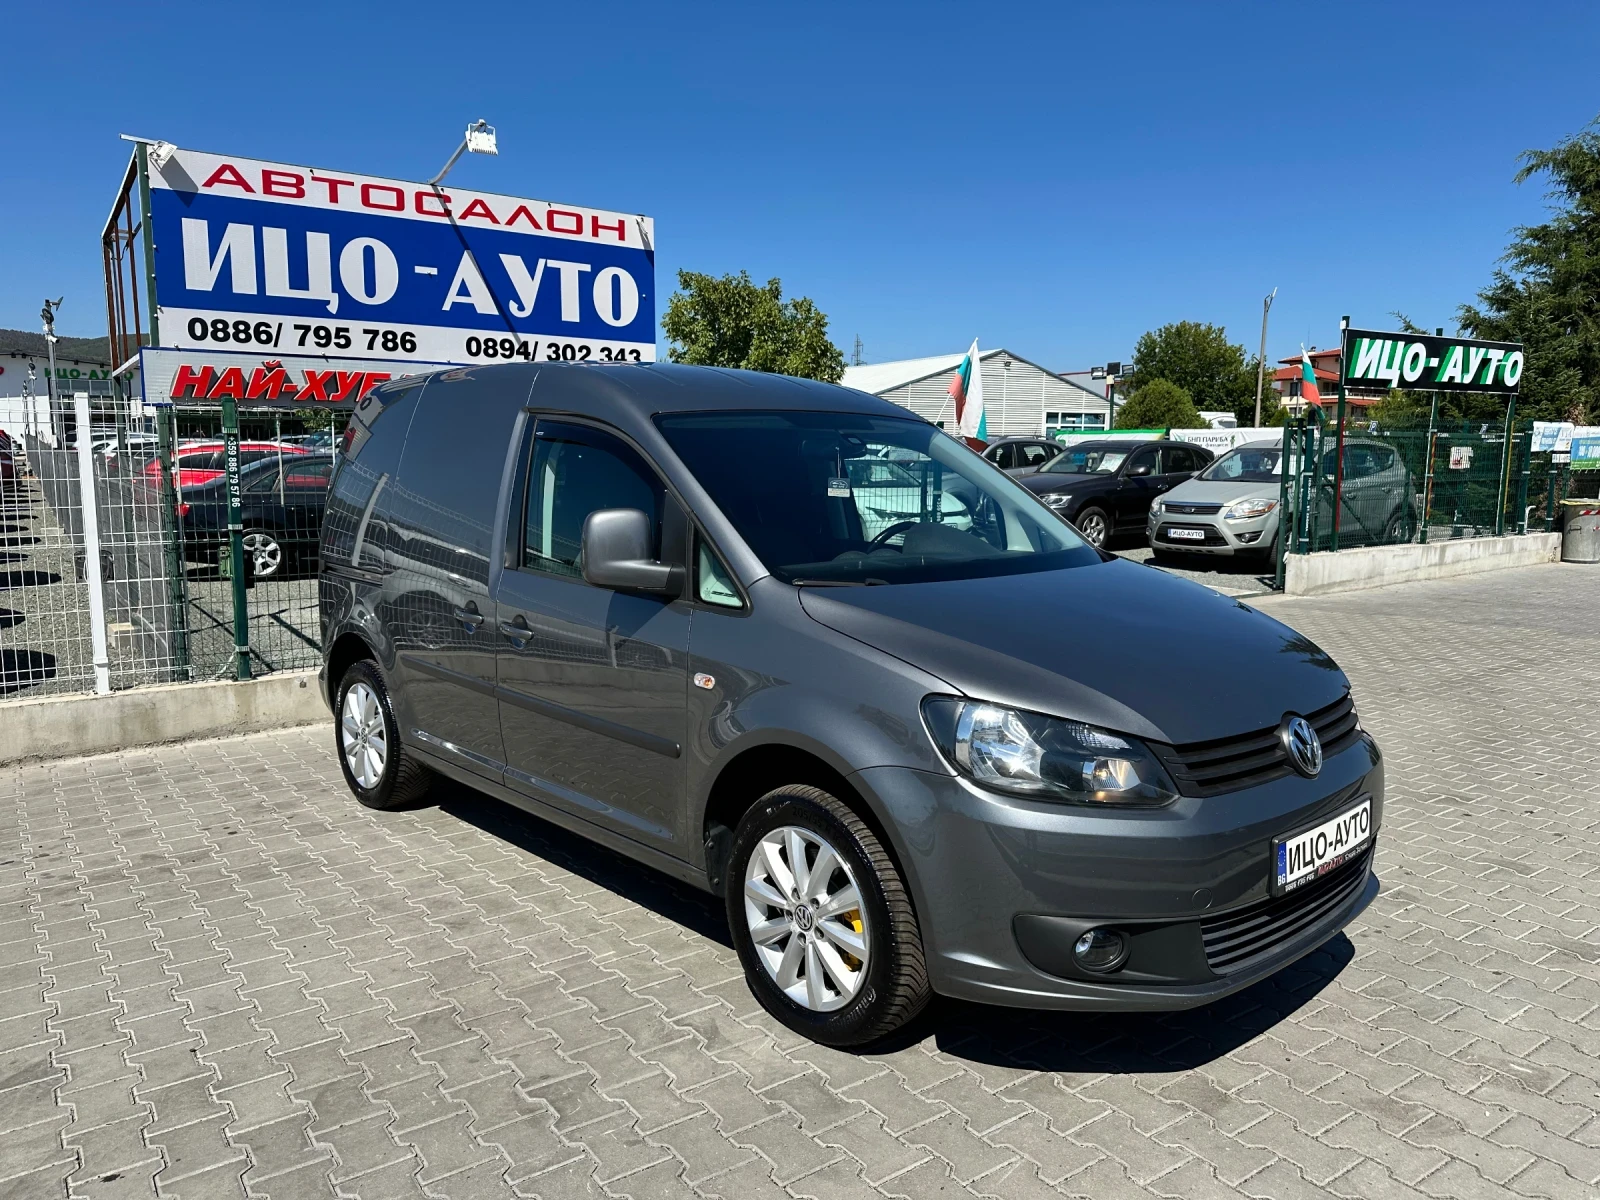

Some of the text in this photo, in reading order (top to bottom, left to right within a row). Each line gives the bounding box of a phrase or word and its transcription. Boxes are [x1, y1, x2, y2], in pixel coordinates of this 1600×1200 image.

[202, 163, 627, 242] АВТОСАЛОН
[187, 316, 418, 353] 0886/ 795 786
[465, 335, 539, 361] 0894/
[546, 342, 592, 362] 302
[44, 367, 134, 381] ИЦО-АУО
[1354, 337, 1524, 389] ИЦО-АУТО
[228, 436, 240, 508] +359 886 79 57 86
[1172, 530, 1203, 538] ИЦО-АУТО
[1288, 806, 1369, 876] ИЦО-АУТО
[1277, 873, 1286, 887] BG
